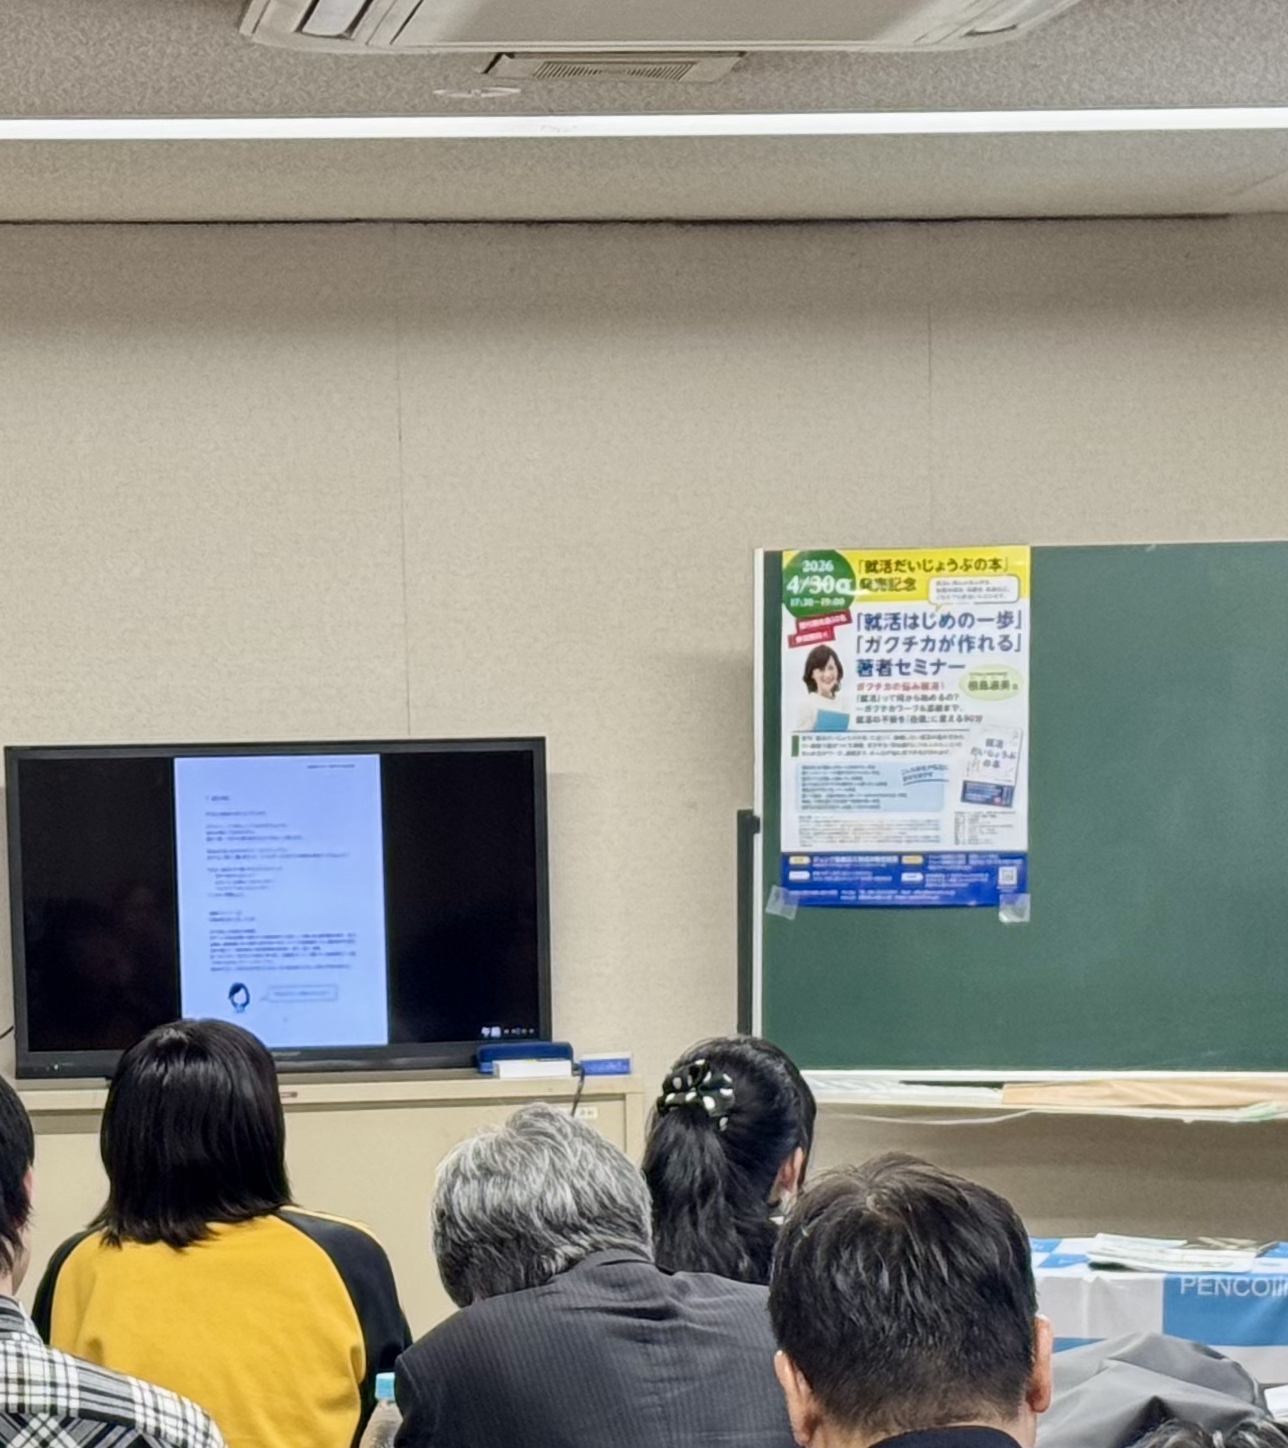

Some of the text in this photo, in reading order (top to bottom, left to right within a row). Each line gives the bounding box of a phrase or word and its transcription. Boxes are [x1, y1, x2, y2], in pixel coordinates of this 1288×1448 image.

[802, 559, 834, 573] 2026
[856, 610, 1022, 632] 「就活はじめの一歩」
[856, 633, 1022, 653] 「ガクチカが作れる」
[856, 658, 966, 677] 著者セミナー
